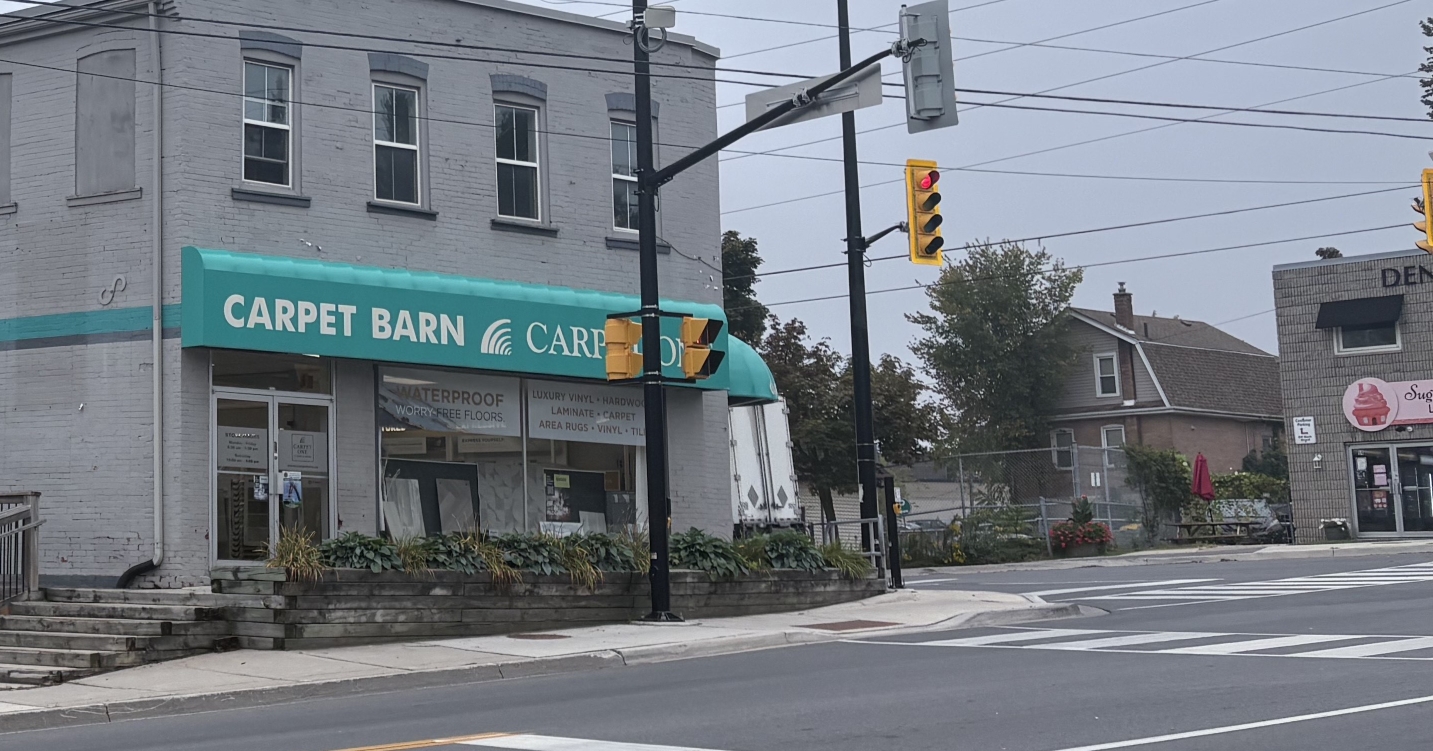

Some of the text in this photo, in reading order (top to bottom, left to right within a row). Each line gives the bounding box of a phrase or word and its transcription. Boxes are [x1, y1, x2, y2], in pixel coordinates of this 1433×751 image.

[223, 294, 465, 347] CARPET BARN
[526, 321, 643, 359] CARP
[396, 386, 504, 407] WATERPROOF
[532, 390, 645, 408] LUXURY VINYL HARDWOO
[395, 404, 506, 423] WORRY-FREE FLOORS.
[551, 406, 636, 421] LAMINATE CARPET
[539, 420, 645, 436] AREA RUGS VINYL TIL
